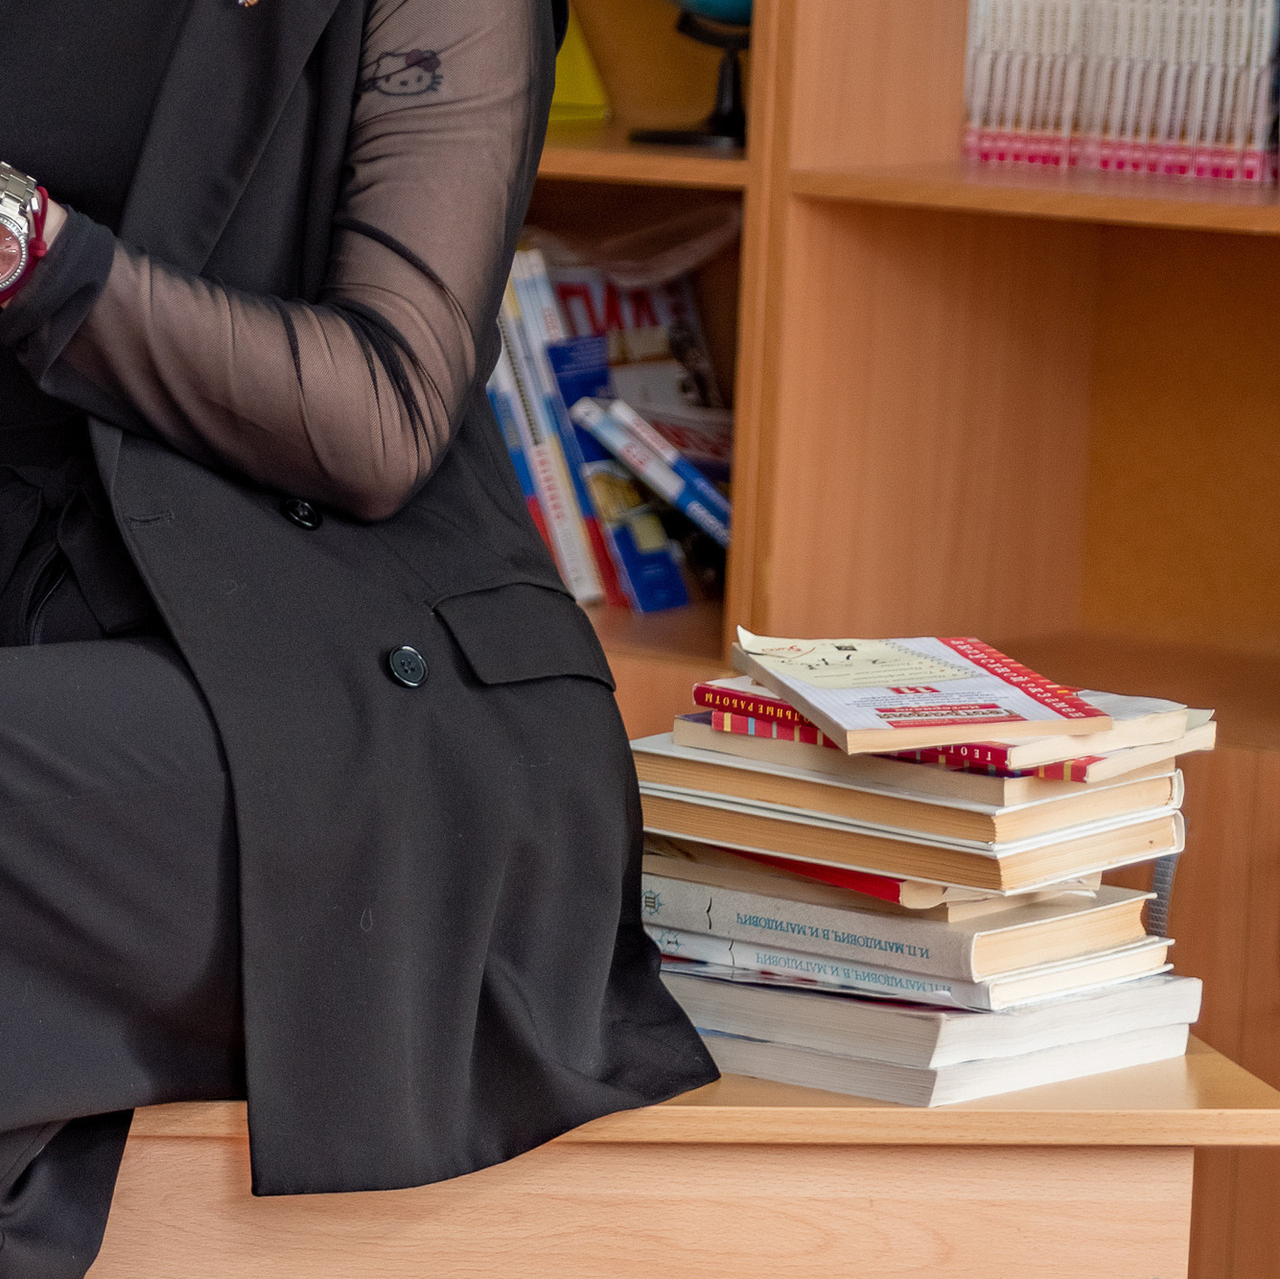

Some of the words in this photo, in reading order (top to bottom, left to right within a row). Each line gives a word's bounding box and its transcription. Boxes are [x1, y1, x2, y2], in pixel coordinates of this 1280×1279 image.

[705, 693, 753, 712] РАБОТЫ
[758, 704, 811, 723] ОЛЬНЫЕ
[736, 913, 807, 936] МАГИДОВИЧ
[831, 930, 905, 955] МАГИДОВИЧ,
[756, 953, 827, 974] МАГИДОВИЧ
